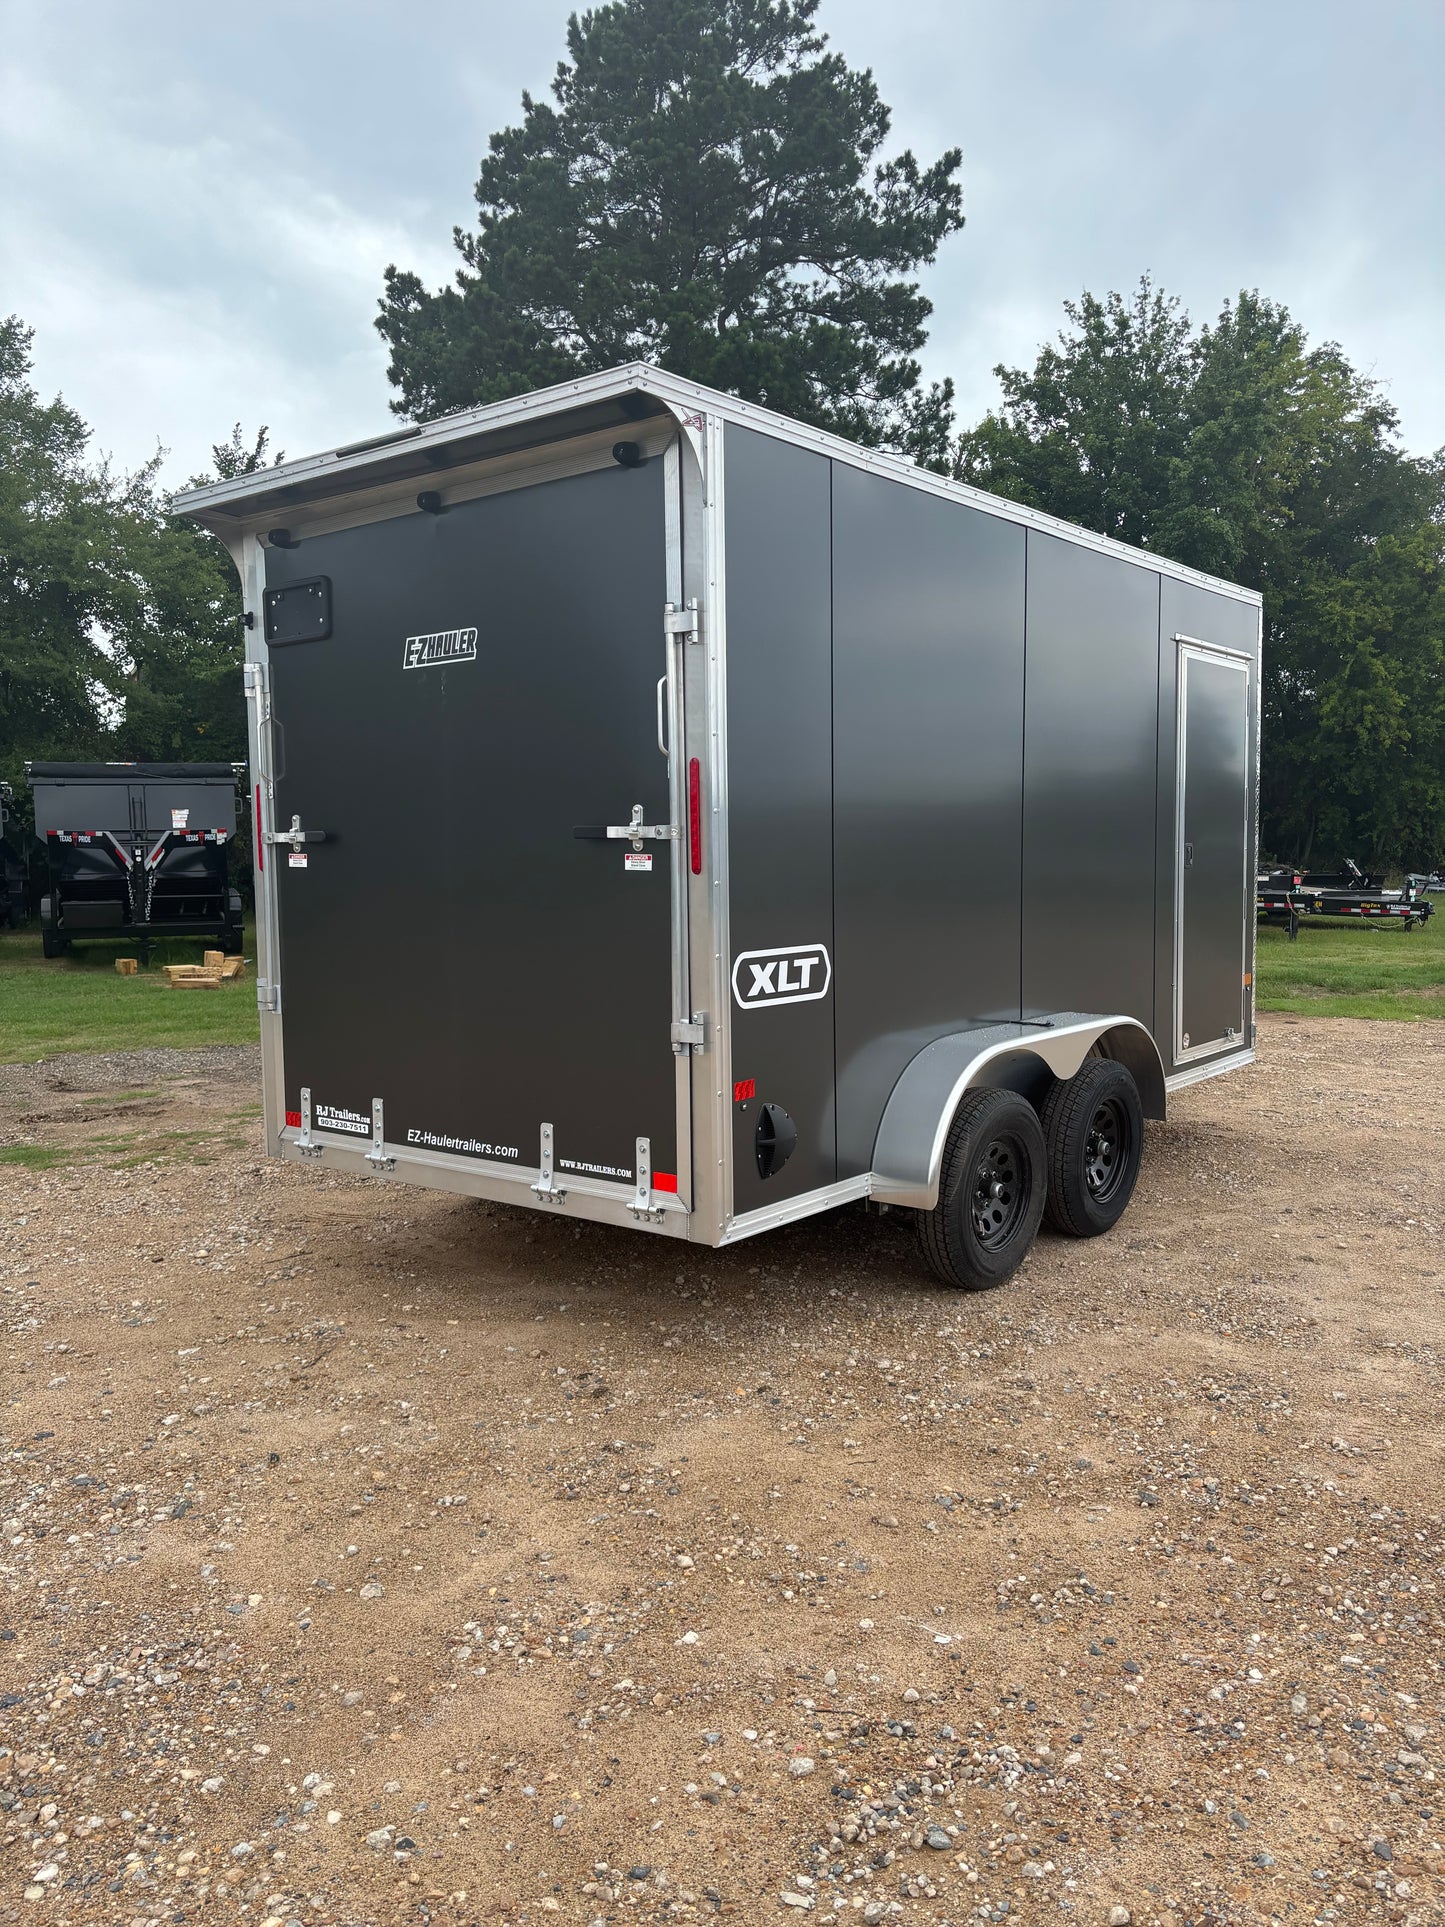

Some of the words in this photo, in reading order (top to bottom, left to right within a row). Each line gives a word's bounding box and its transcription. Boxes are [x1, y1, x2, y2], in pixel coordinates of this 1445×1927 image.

[59, 835, 72, 843] TEXAS
[78, 835, 91, 843] PRIDE
[747, 957, 819, 997] XLT
[316, 1104, 329, 1117] RJ
[320, 1118, 367, 1132] 903-230-7511
[407, 1129, 519, 1158] EZ-Haulertrailers.com
[560, 1159, 632, 1178] WWW.RJTRAILERS.COM
